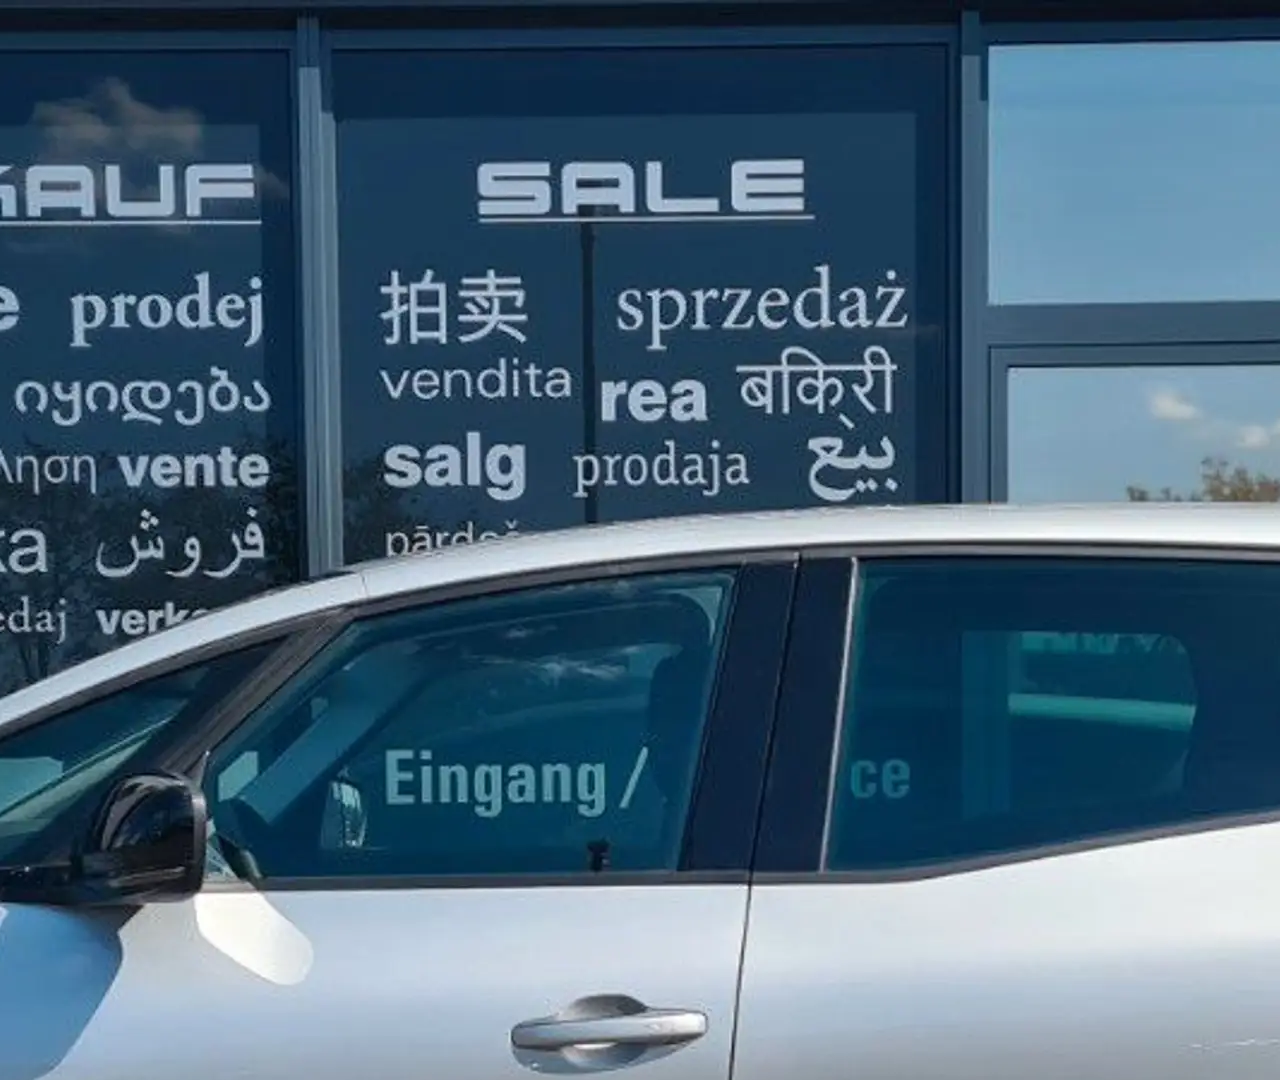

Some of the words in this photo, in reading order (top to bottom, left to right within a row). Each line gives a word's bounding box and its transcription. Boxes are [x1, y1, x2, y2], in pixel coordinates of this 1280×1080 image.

[477, 159, 805, 213] SALE
[69, 271, 263, 348] prodej
[380, 268, 528, 345] 拍卖
[617, 264, 908, 350] sprzedaż
[14, 366, 271, 427] იყიდება
[380, 357, 572, 400] vendita
[601, 379, 708, 422] rea
[117, 446, 270, 488] vente
[383, 431, 526, 502] salg
[572, 439, 750, 498] prodaja
[95, 506, 265, 579] فروش
[95, 601, 210, 635] verk
[385, 749, 606, 818] Eingang
